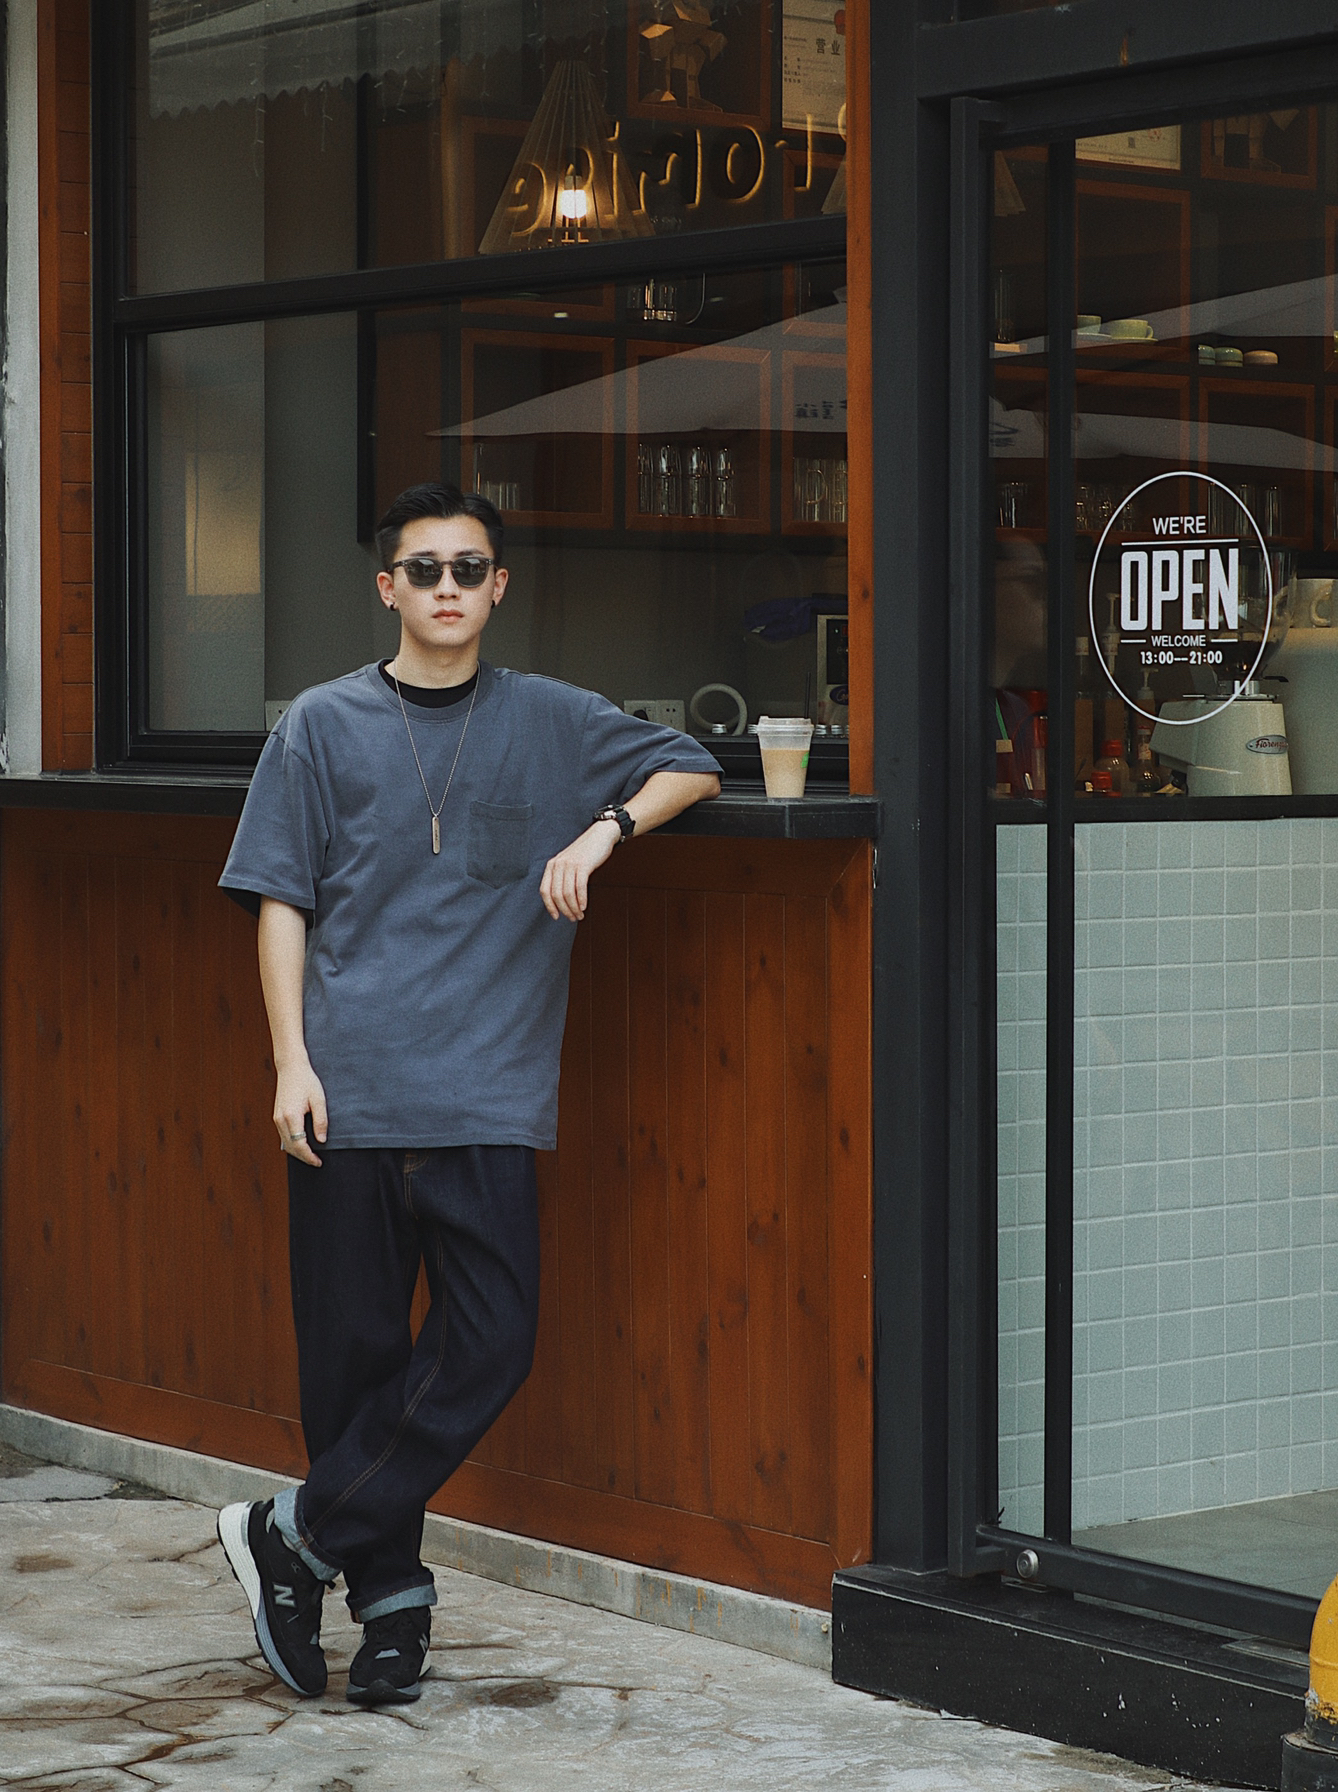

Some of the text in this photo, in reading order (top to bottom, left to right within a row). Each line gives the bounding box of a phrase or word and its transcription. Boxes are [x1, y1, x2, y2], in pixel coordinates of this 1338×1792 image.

[816, 38, 840, 56] 营业
[1152, 515, 1207, 536] WE'RE
[1121, 548, 1239, 630] OPEN
[1151, 634, 1206, 647] WELCOME
[273, 1583, 296, 1608] N
